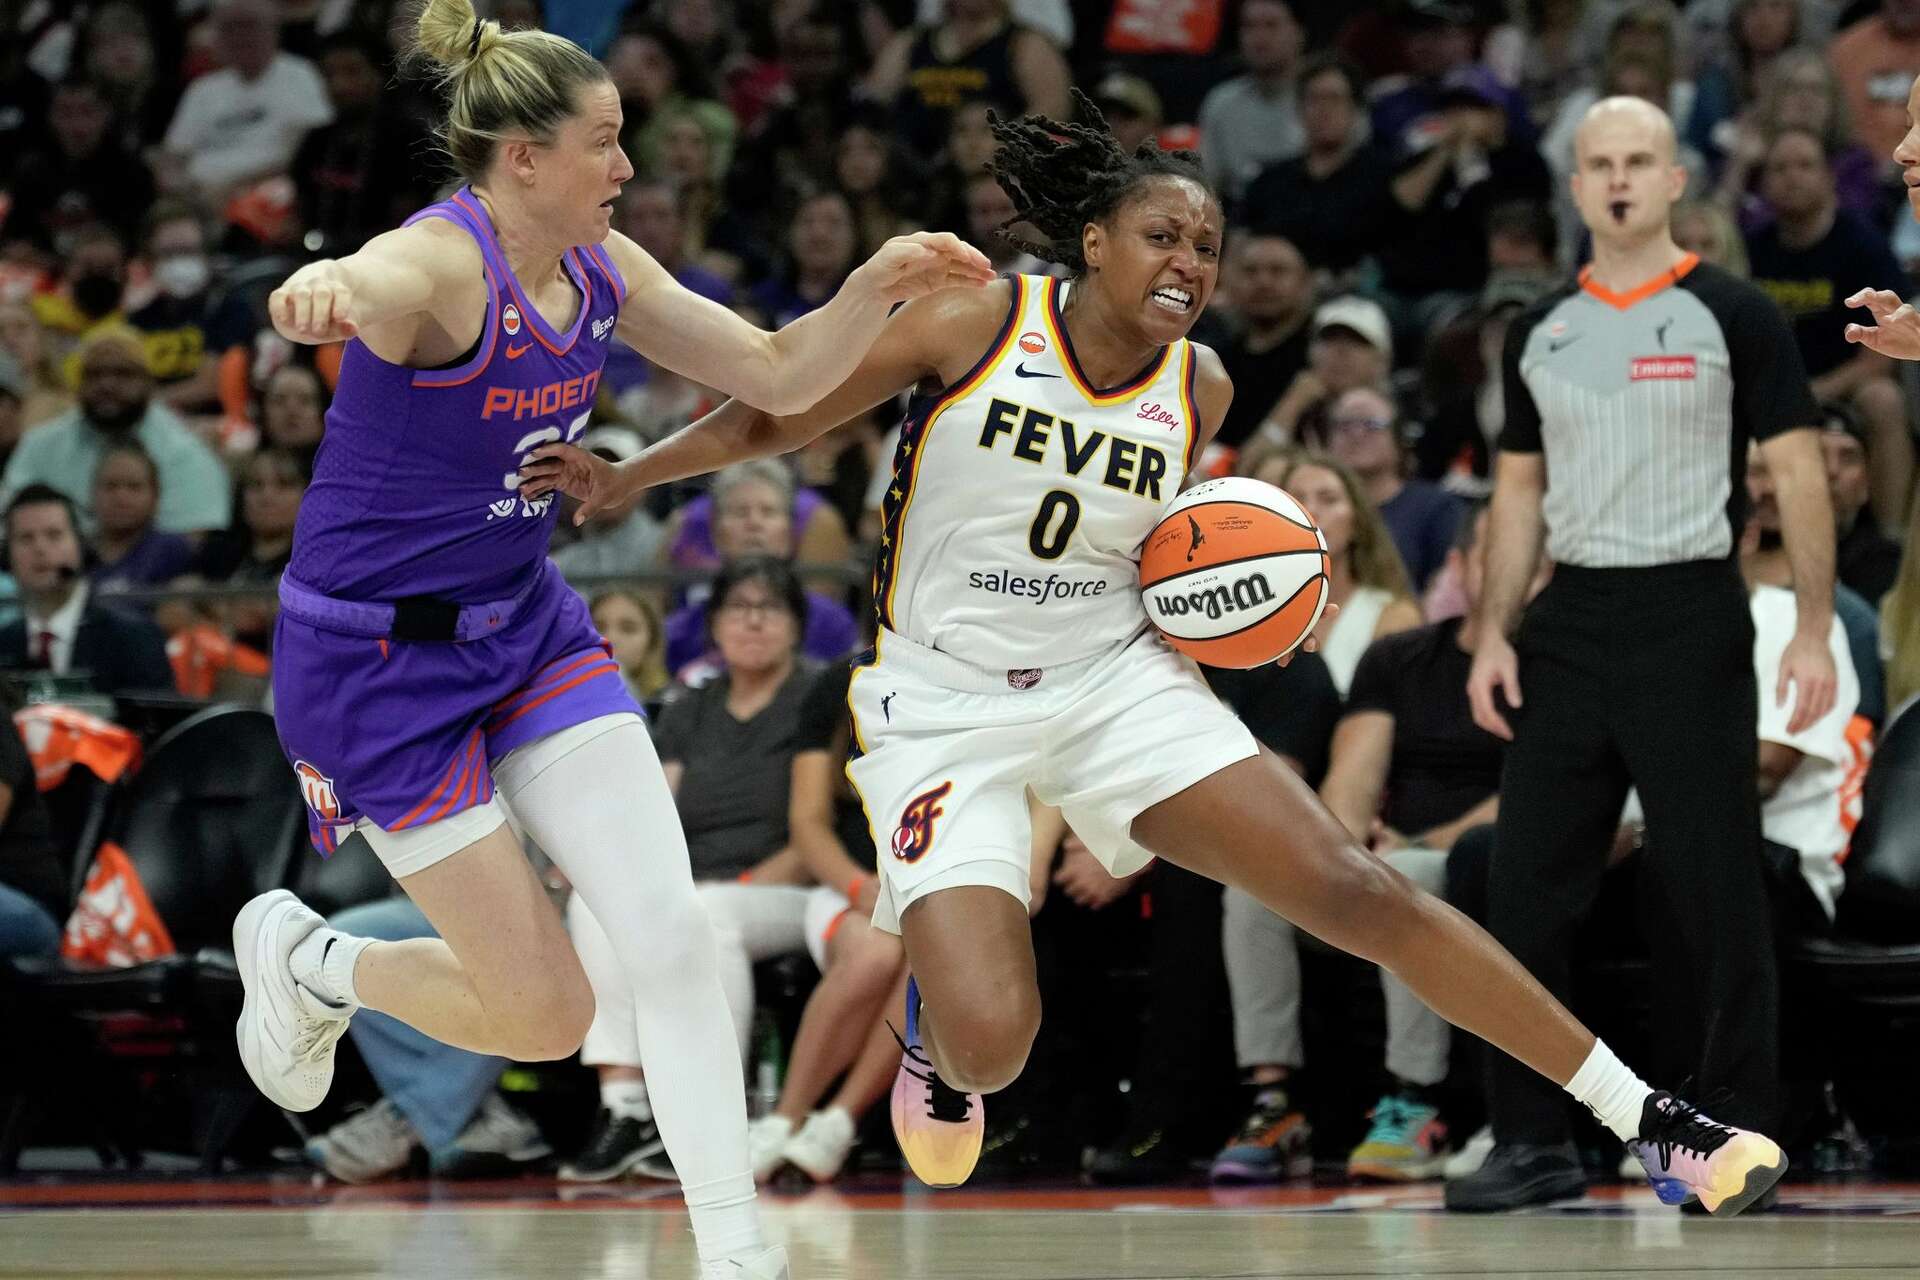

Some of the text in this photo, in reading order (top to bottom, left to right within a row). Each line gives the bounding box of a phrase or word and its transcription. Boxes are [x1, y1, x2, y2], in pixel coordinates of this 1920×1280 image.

[1631, 361, 1697, 378] Emirates
[480, 369, 602, 420] PHOEN
[1136, 402, 1179, 431] Lilly
[977, 397, 1168, 503] FEVER
[1027, 486, 1083, 561] 0
[968, 569, 1107, 605] salesforce
[1153, 572, 1277, 620] Wilson
